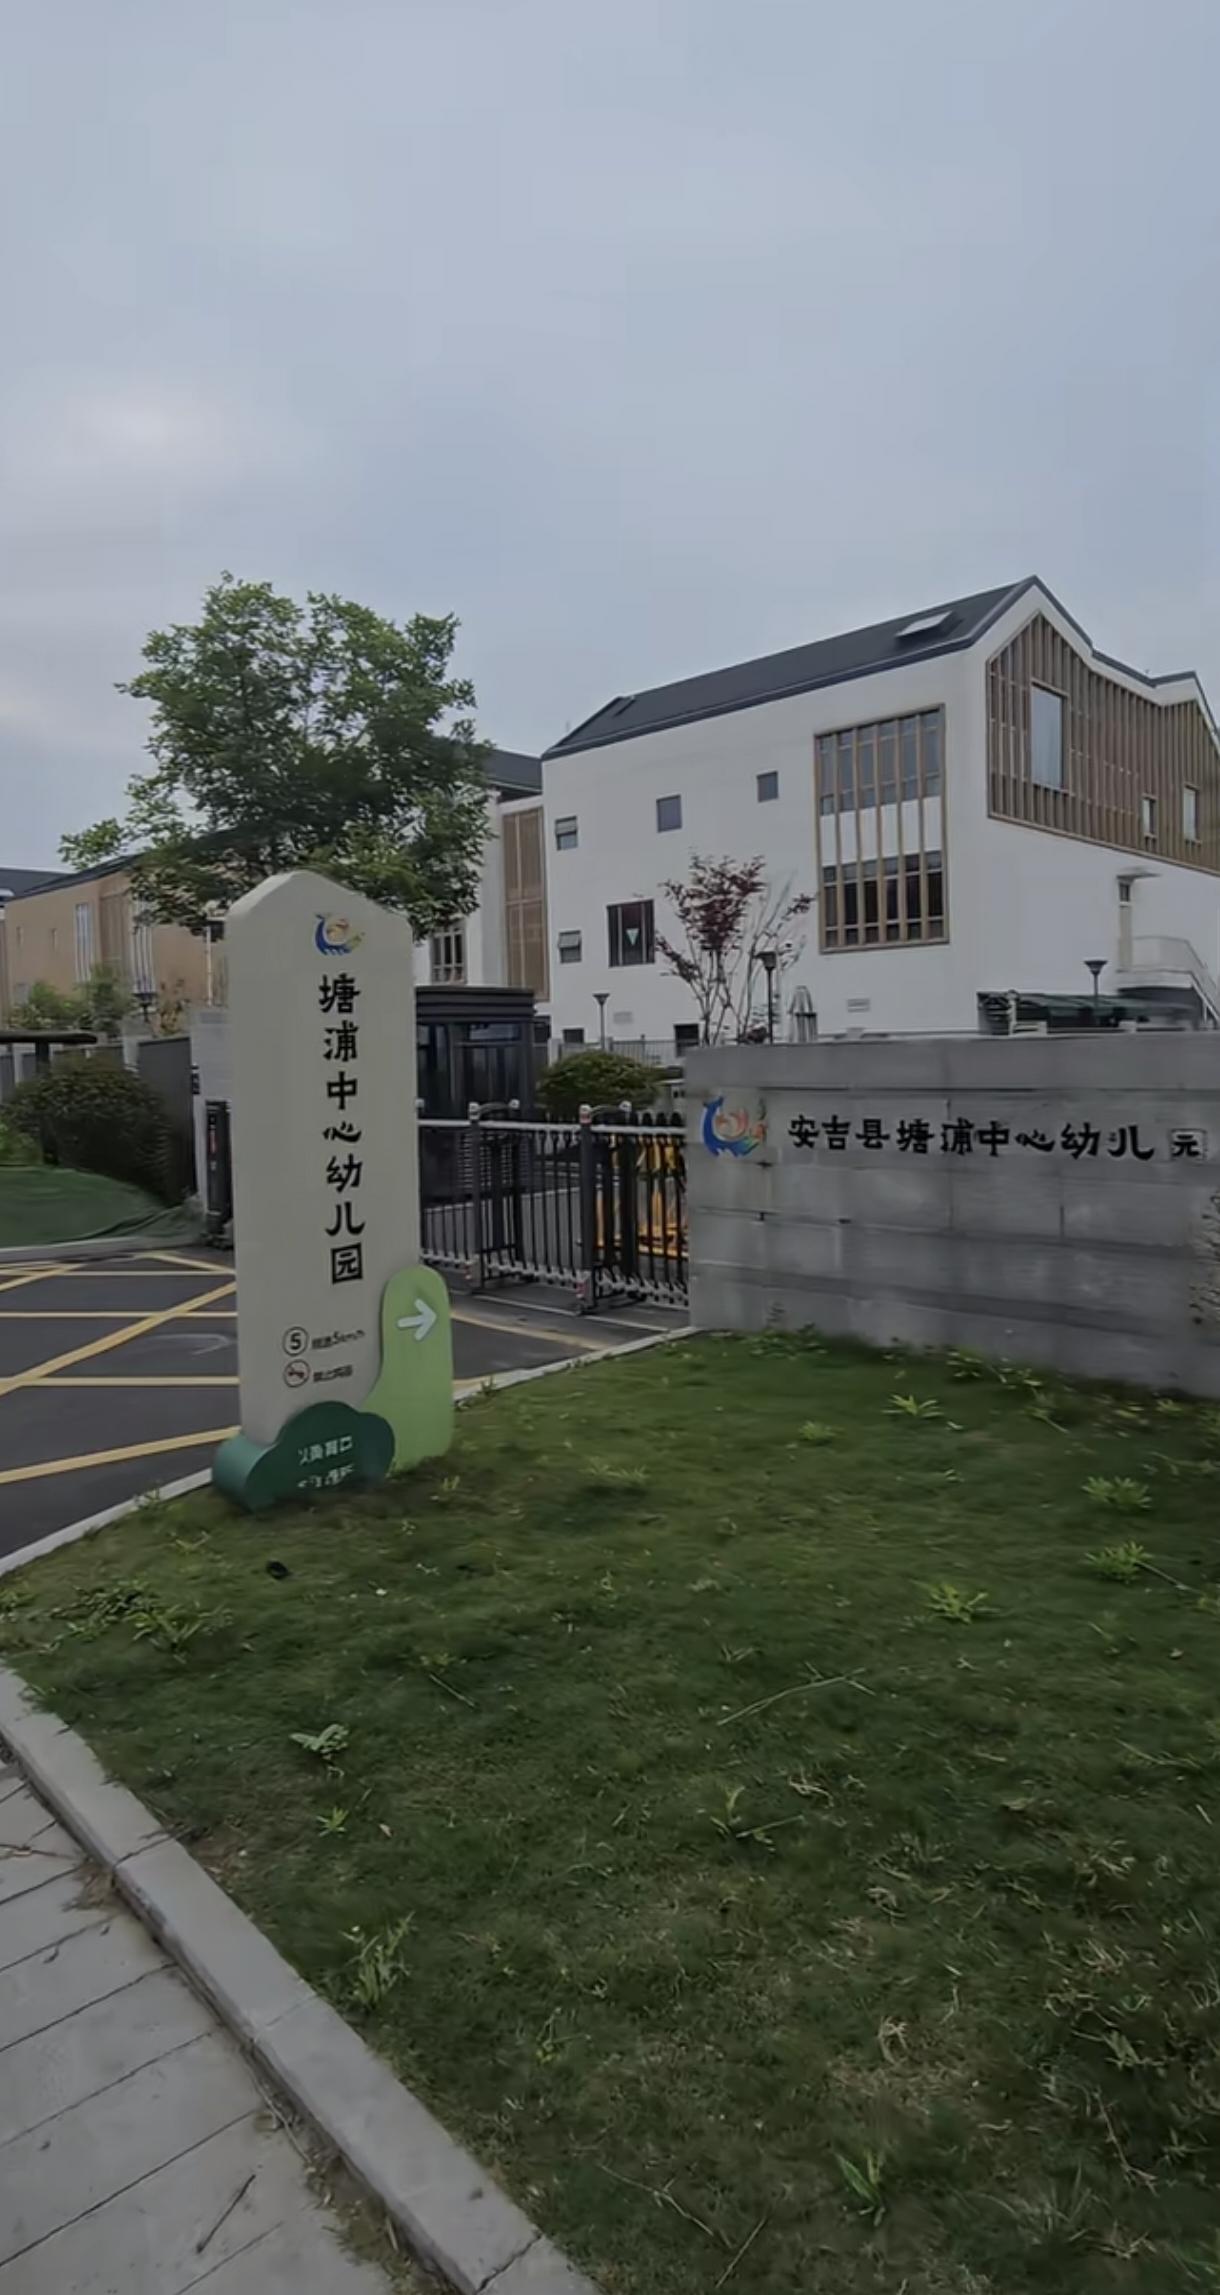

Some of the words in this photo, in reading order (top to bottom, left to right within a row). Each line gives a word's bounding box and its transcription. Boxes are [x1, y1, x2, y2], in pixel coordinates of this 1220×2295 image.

[318, 973, 366, 1285] 塘浦中心幼儿园
[788, 1114, 1207, 1161] 安吉县塘浦中心幼儿园
[290, 1332, 302, 1350] 5
